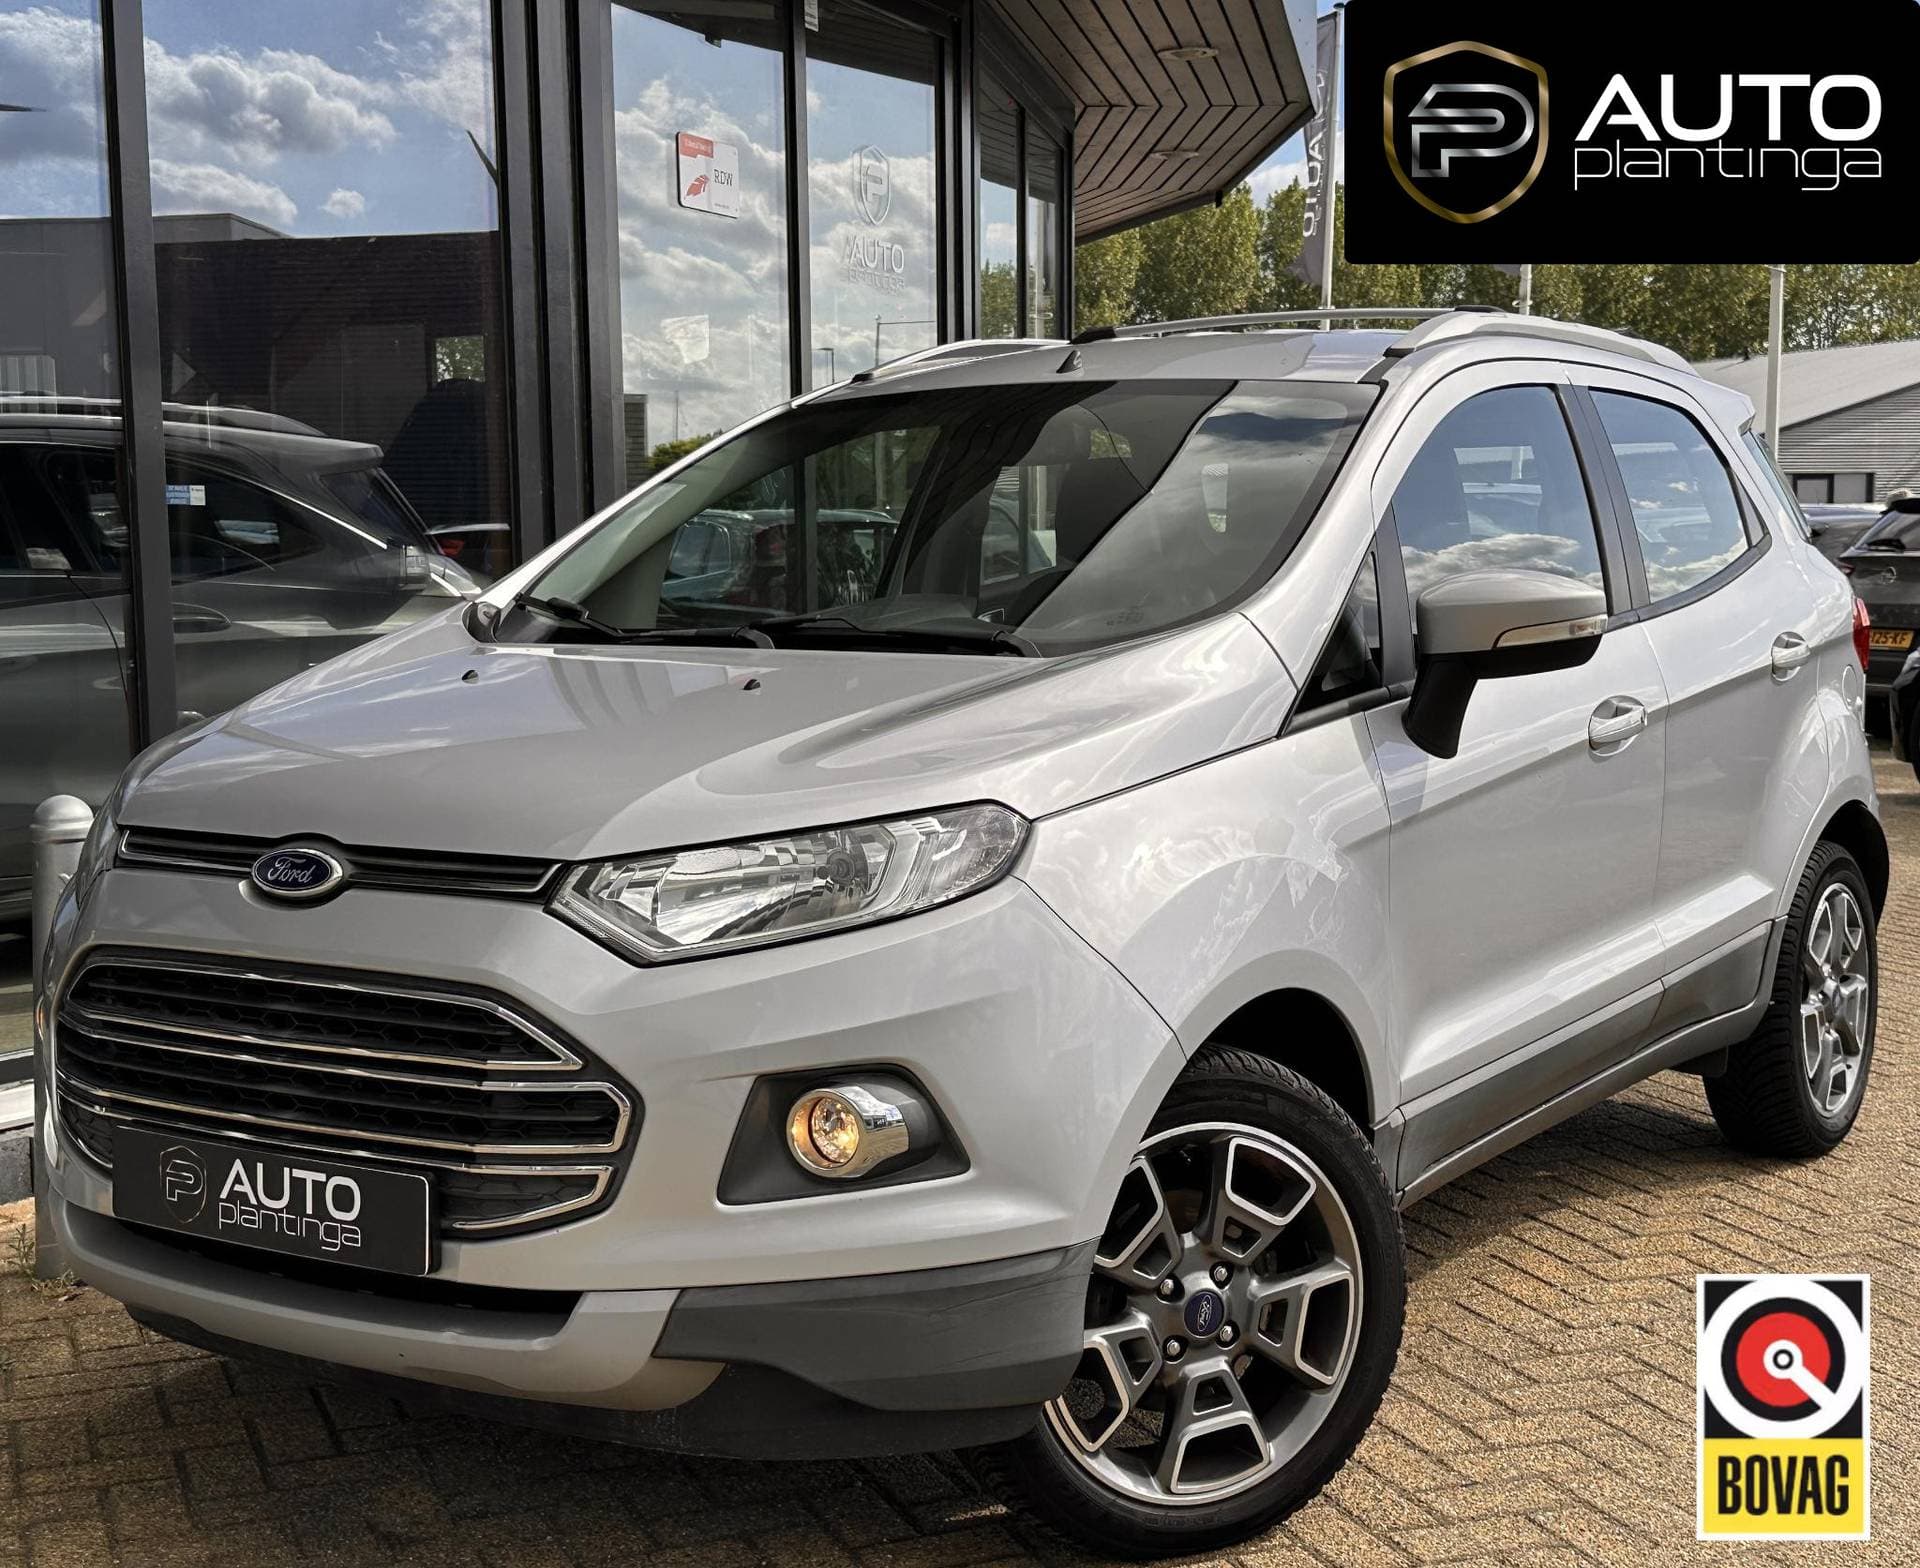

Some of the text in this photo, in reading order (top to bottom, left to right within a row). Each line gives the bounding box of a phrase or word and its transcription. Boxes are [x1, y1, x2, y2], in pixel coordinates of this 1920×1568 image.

[714, 169, 733, 187] RDW
[849, 236, 904, 273] AUTO
[267, 856, 316, 883] Ford
[219, 1158, 361, 1221] AUTO
[218, 1199, 361, 1251] plantinga
